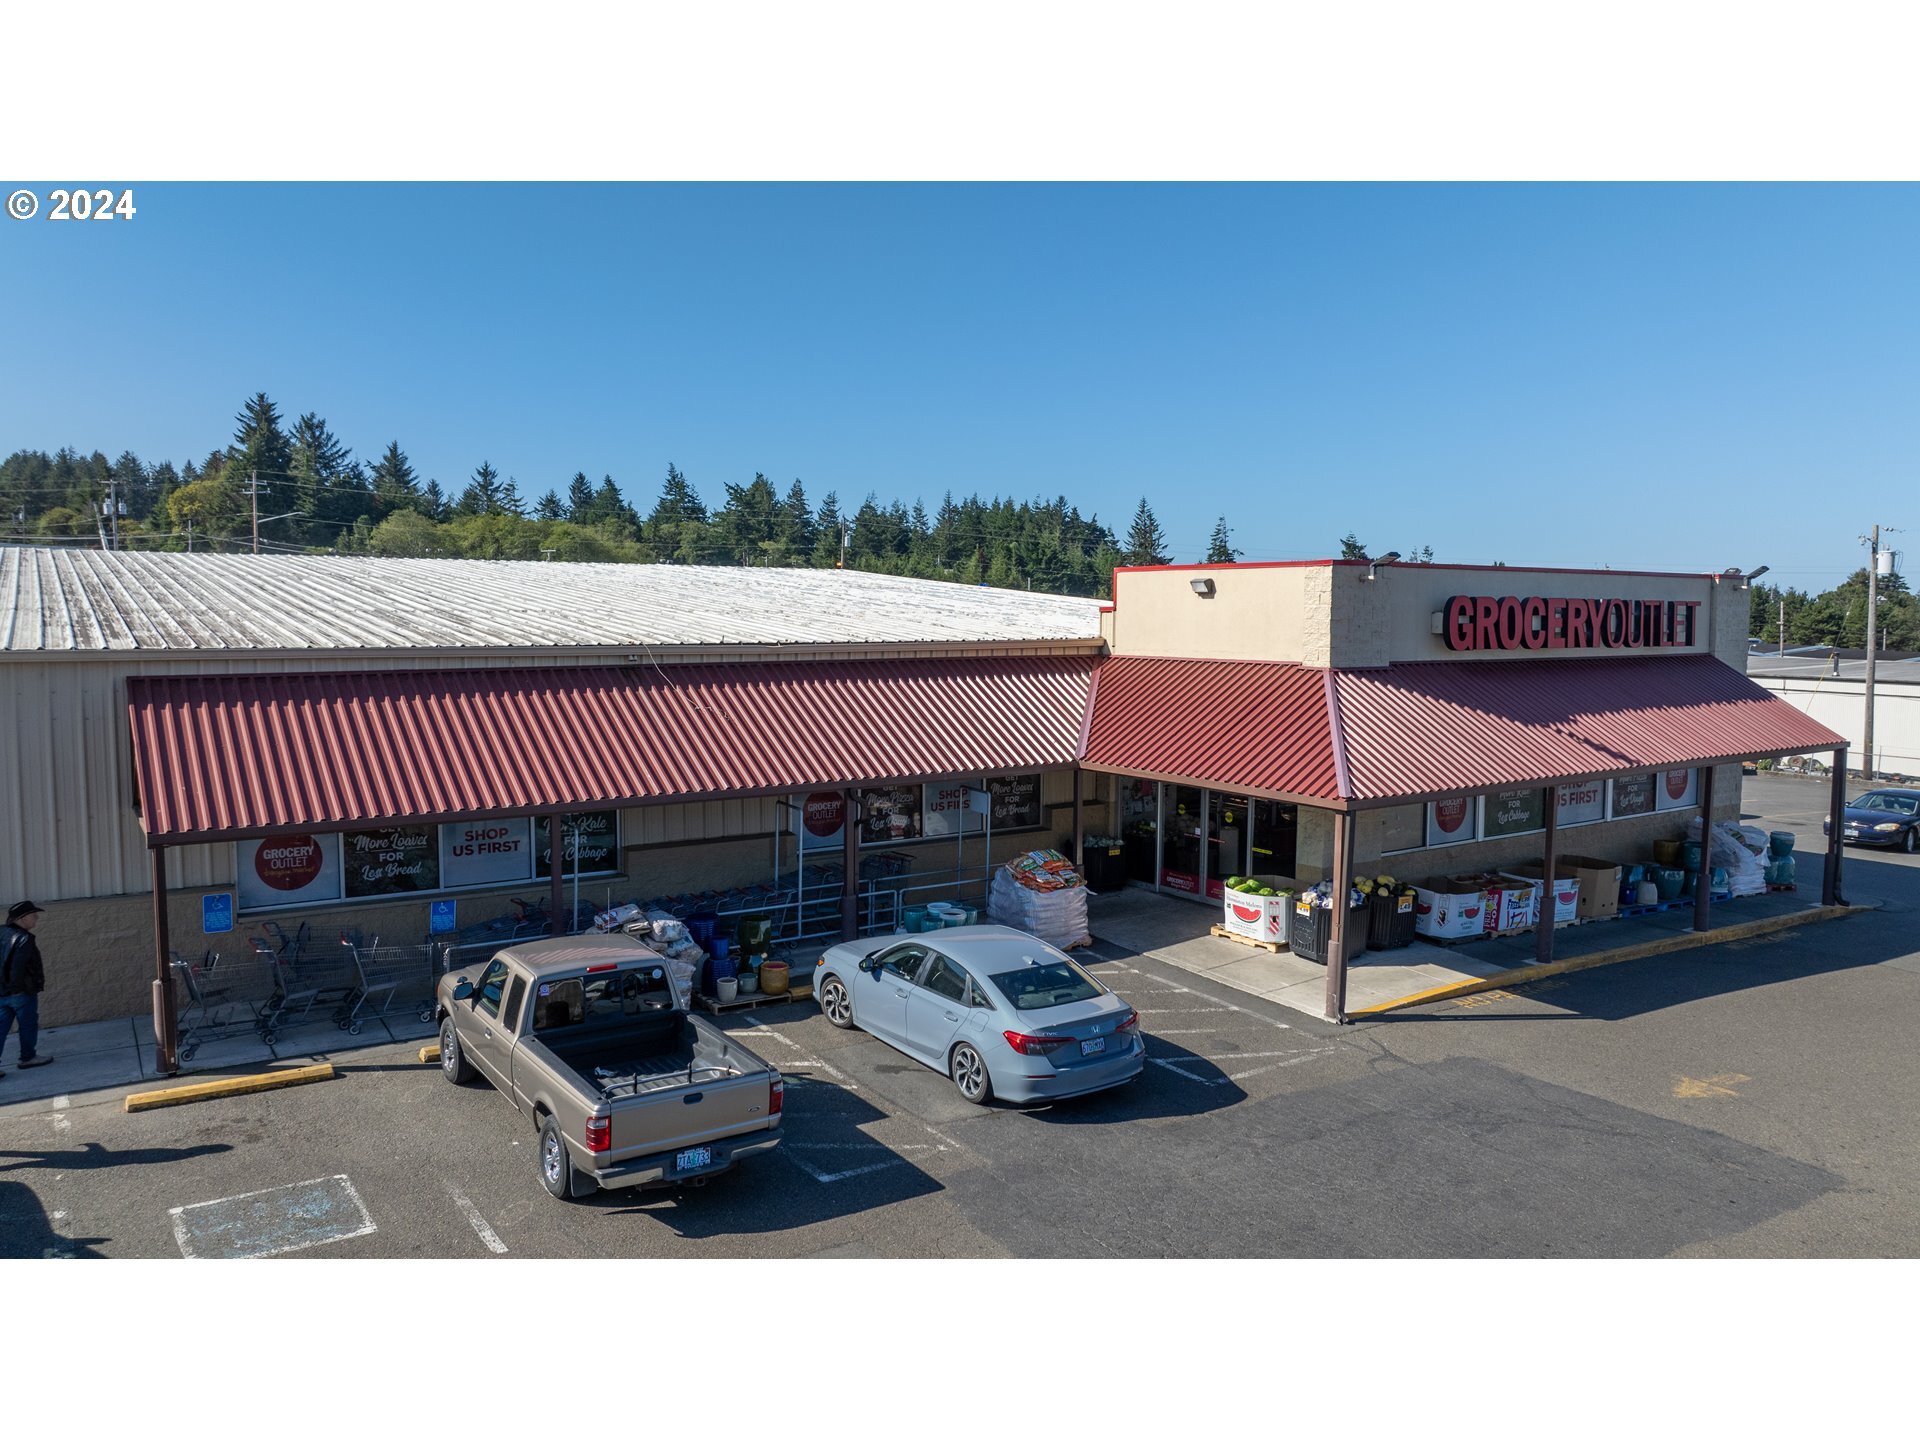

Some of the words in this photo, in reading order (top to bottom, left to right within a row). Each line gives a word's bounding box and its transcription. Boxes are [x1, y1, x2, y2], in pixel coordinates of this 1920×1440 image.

[991, 783, 1011, 795] More
[1569, 789, 1598, 805] FIRST
[807, 801, 841, 812] GROCERY
[930, 801, 945, 812] US
[1508, 800, 1521, 808] FOR
[812, 810, 837, 820] OUTLET
[882, 807, 900, 815] FOR
[577, 815, 608, 832] Kale
[465, 828, 508, 842] SHOP
[354, 834, 390, 852] More
[390, 832, 428, 850] Loaves
[453, 844, 474, 857] US
[478, 840, 520, 854] FIRST
[263, 845, 314, 860] GROCERY
[379, 852, 405, 862] FOR
[271, 856, 308, 869] OUTLET
[361, 865, 383, 881] Less
[385, 862, 422, 878] Bread
